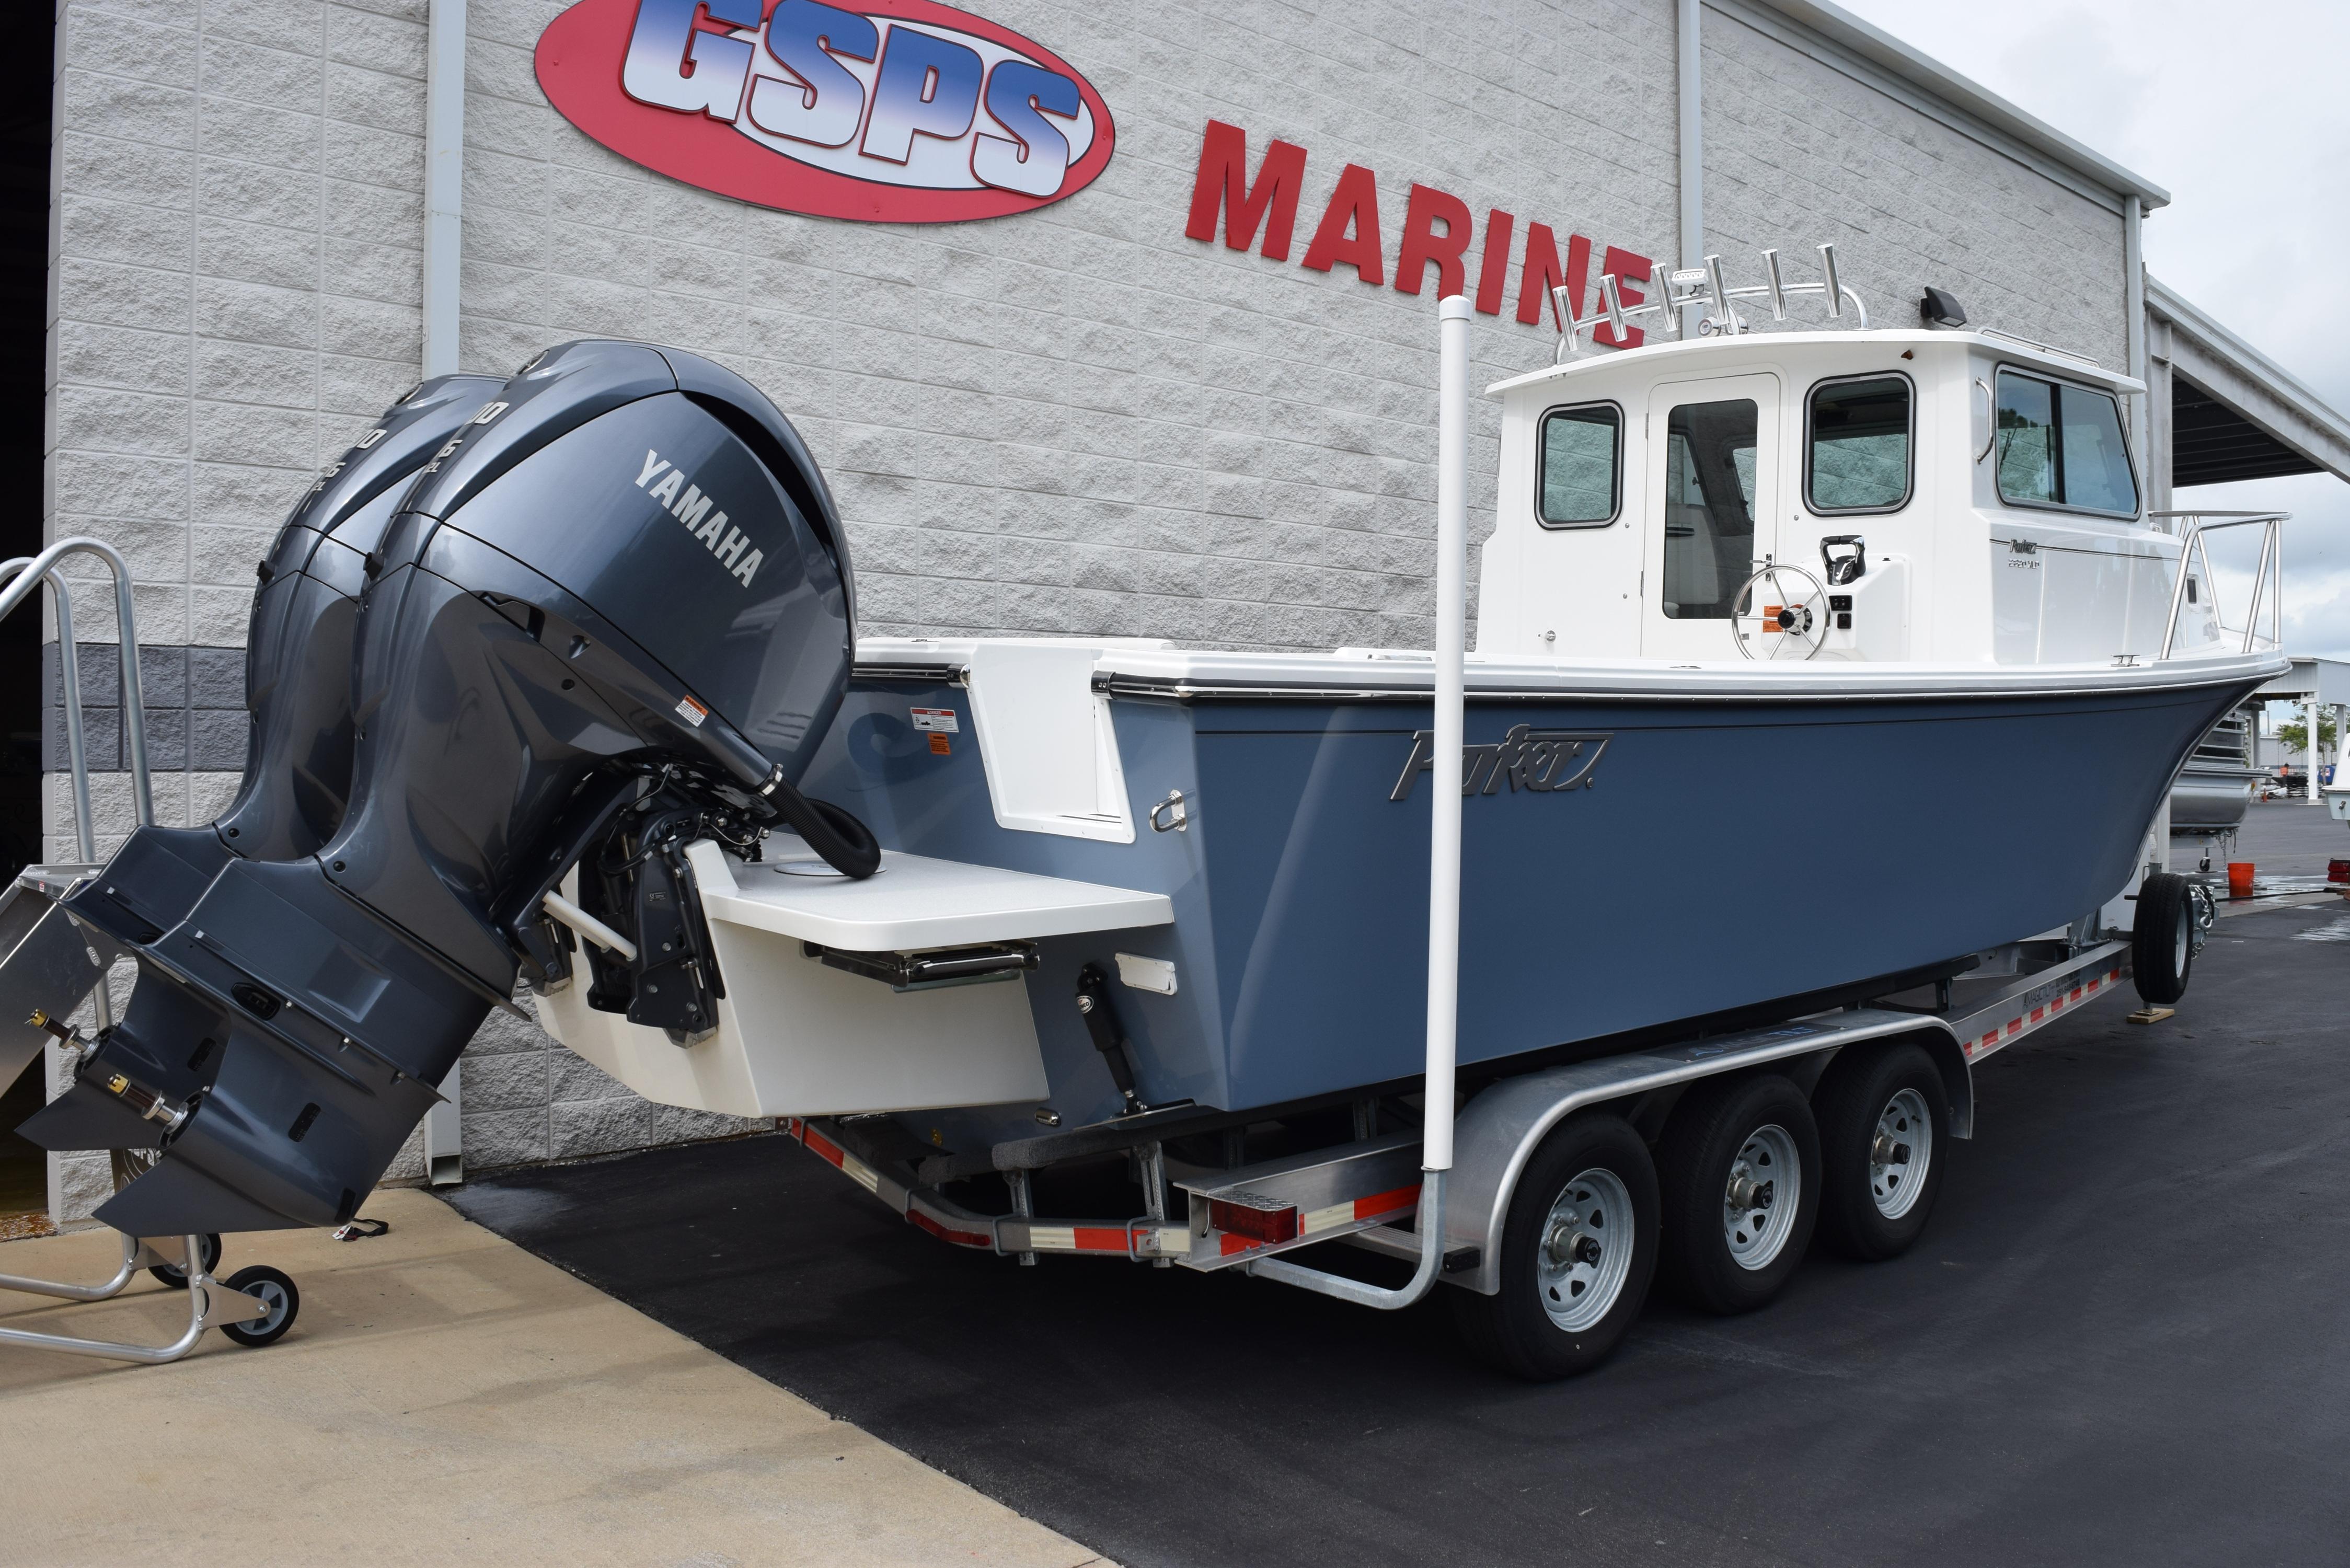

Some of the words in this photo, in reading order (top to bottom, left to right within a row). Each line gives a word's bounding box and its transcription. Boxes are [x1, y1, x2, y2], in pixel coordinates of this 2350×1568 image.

[620, 0, 1081, 199] GSPS
[1184, 119, 1653, 350] MARINE
[635, 448, 764, 589] YAMAHA
